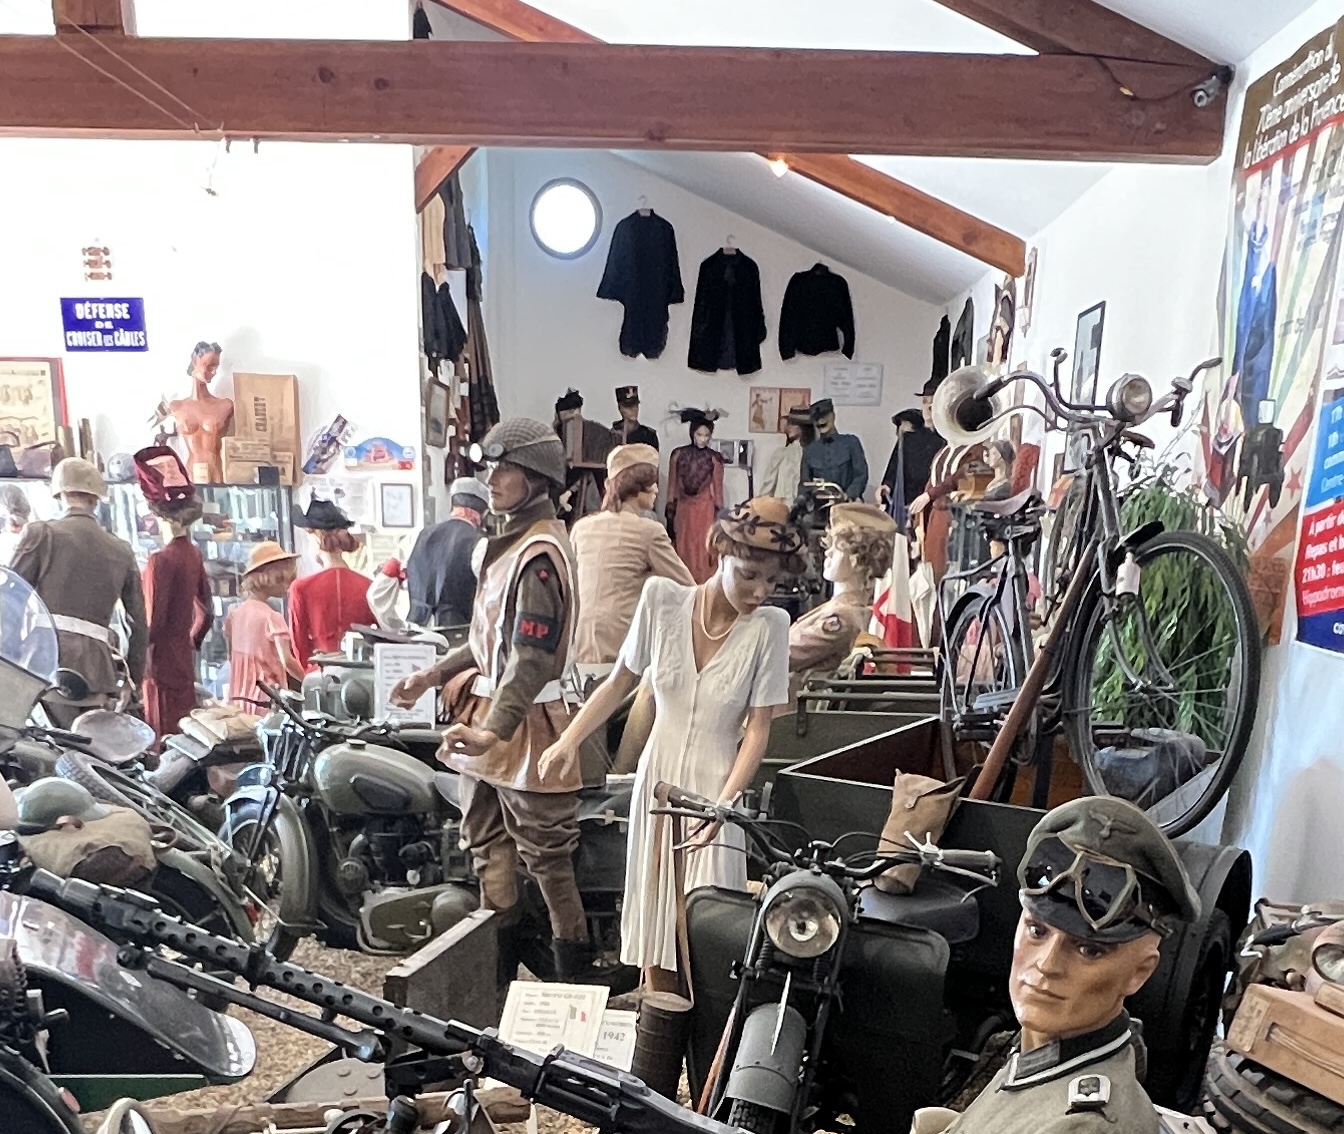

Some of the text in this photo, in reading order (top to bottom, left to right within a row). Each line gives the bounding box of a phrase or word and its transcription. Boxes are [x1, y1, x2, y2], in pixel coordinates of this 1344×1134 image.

[75, 300, 131, 320] DÉFENSE
[1314, 512, 1337, 537] partir
[1329, 538, 1338, 552] et
[1302, 563, 1327, 584] 21h30
[520, 619, 549, 639] MP
